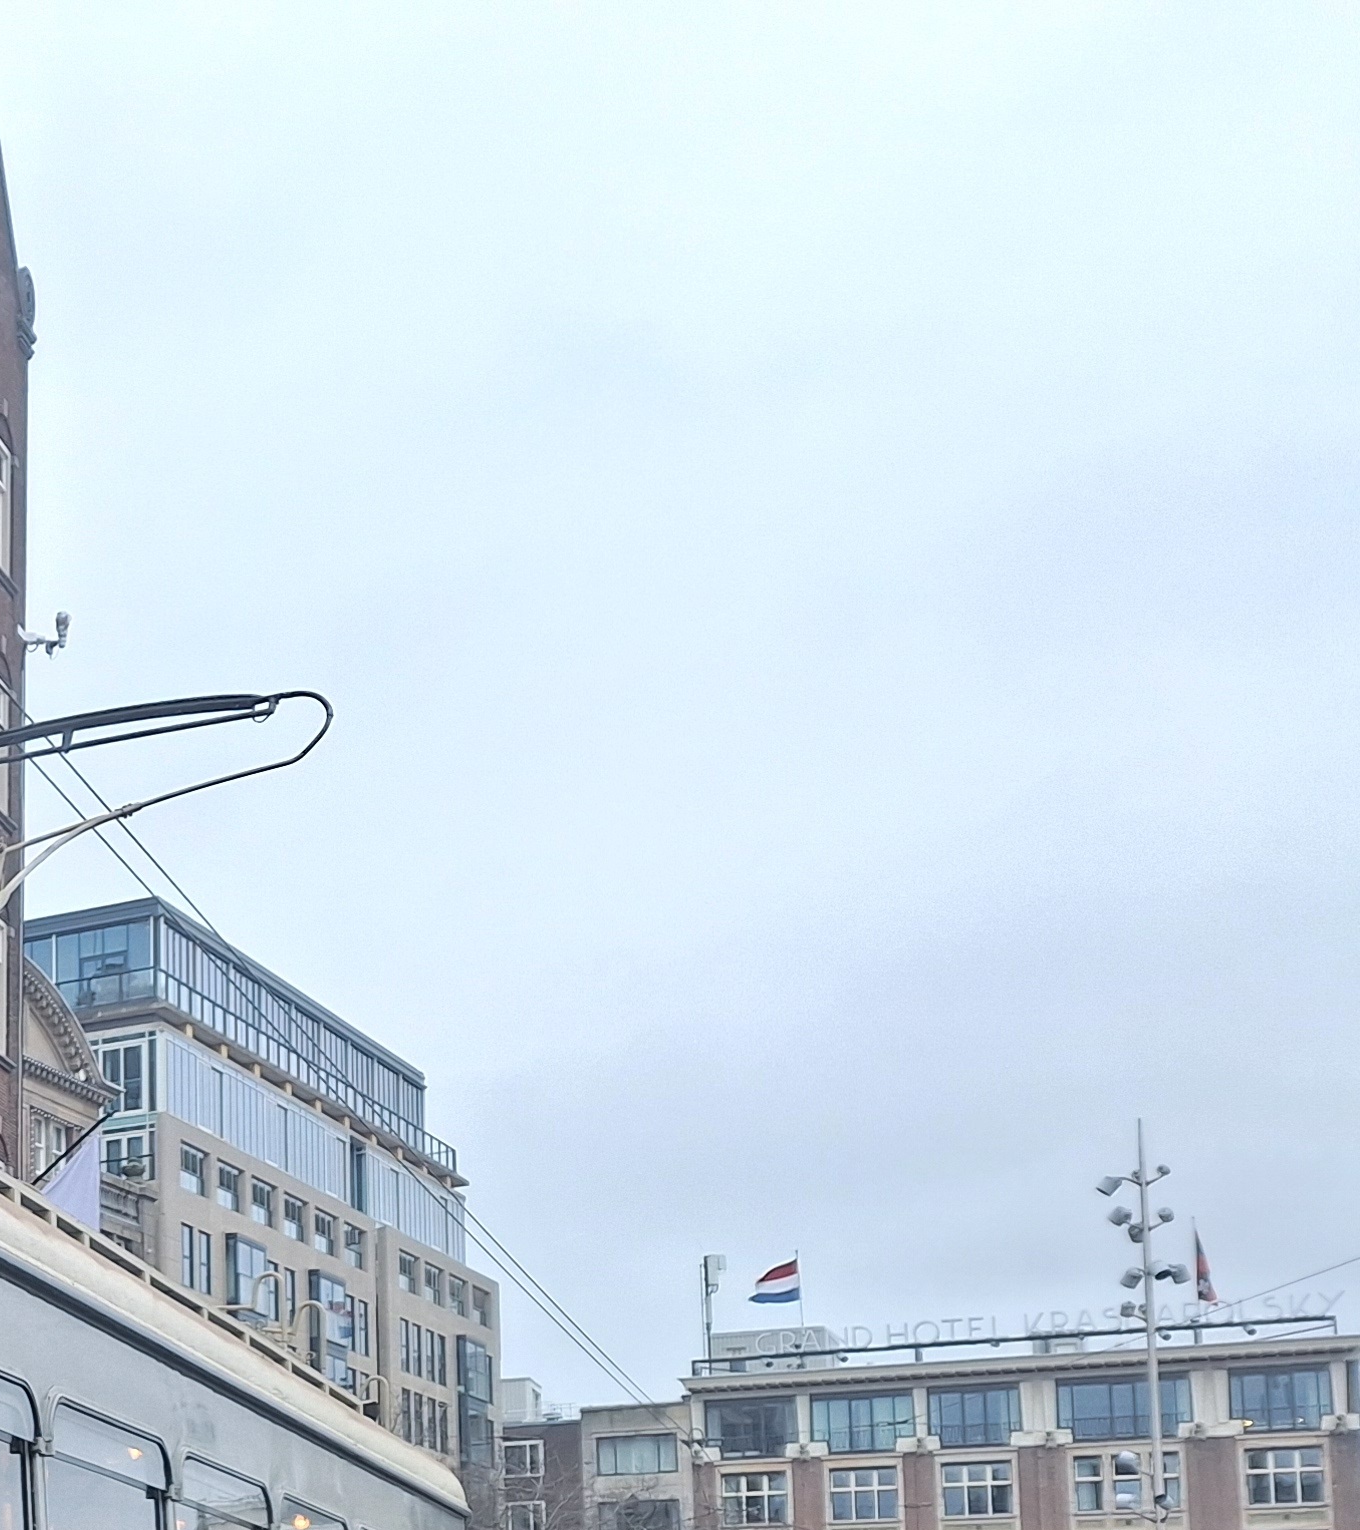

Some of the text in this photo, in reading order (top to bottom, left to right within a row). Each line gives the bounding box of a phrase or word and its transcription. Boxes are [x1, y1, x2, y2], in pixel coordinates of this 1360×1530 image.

[755, 1289, 1347, 1354] GRAND HOTEL KRASAPOLSKY
